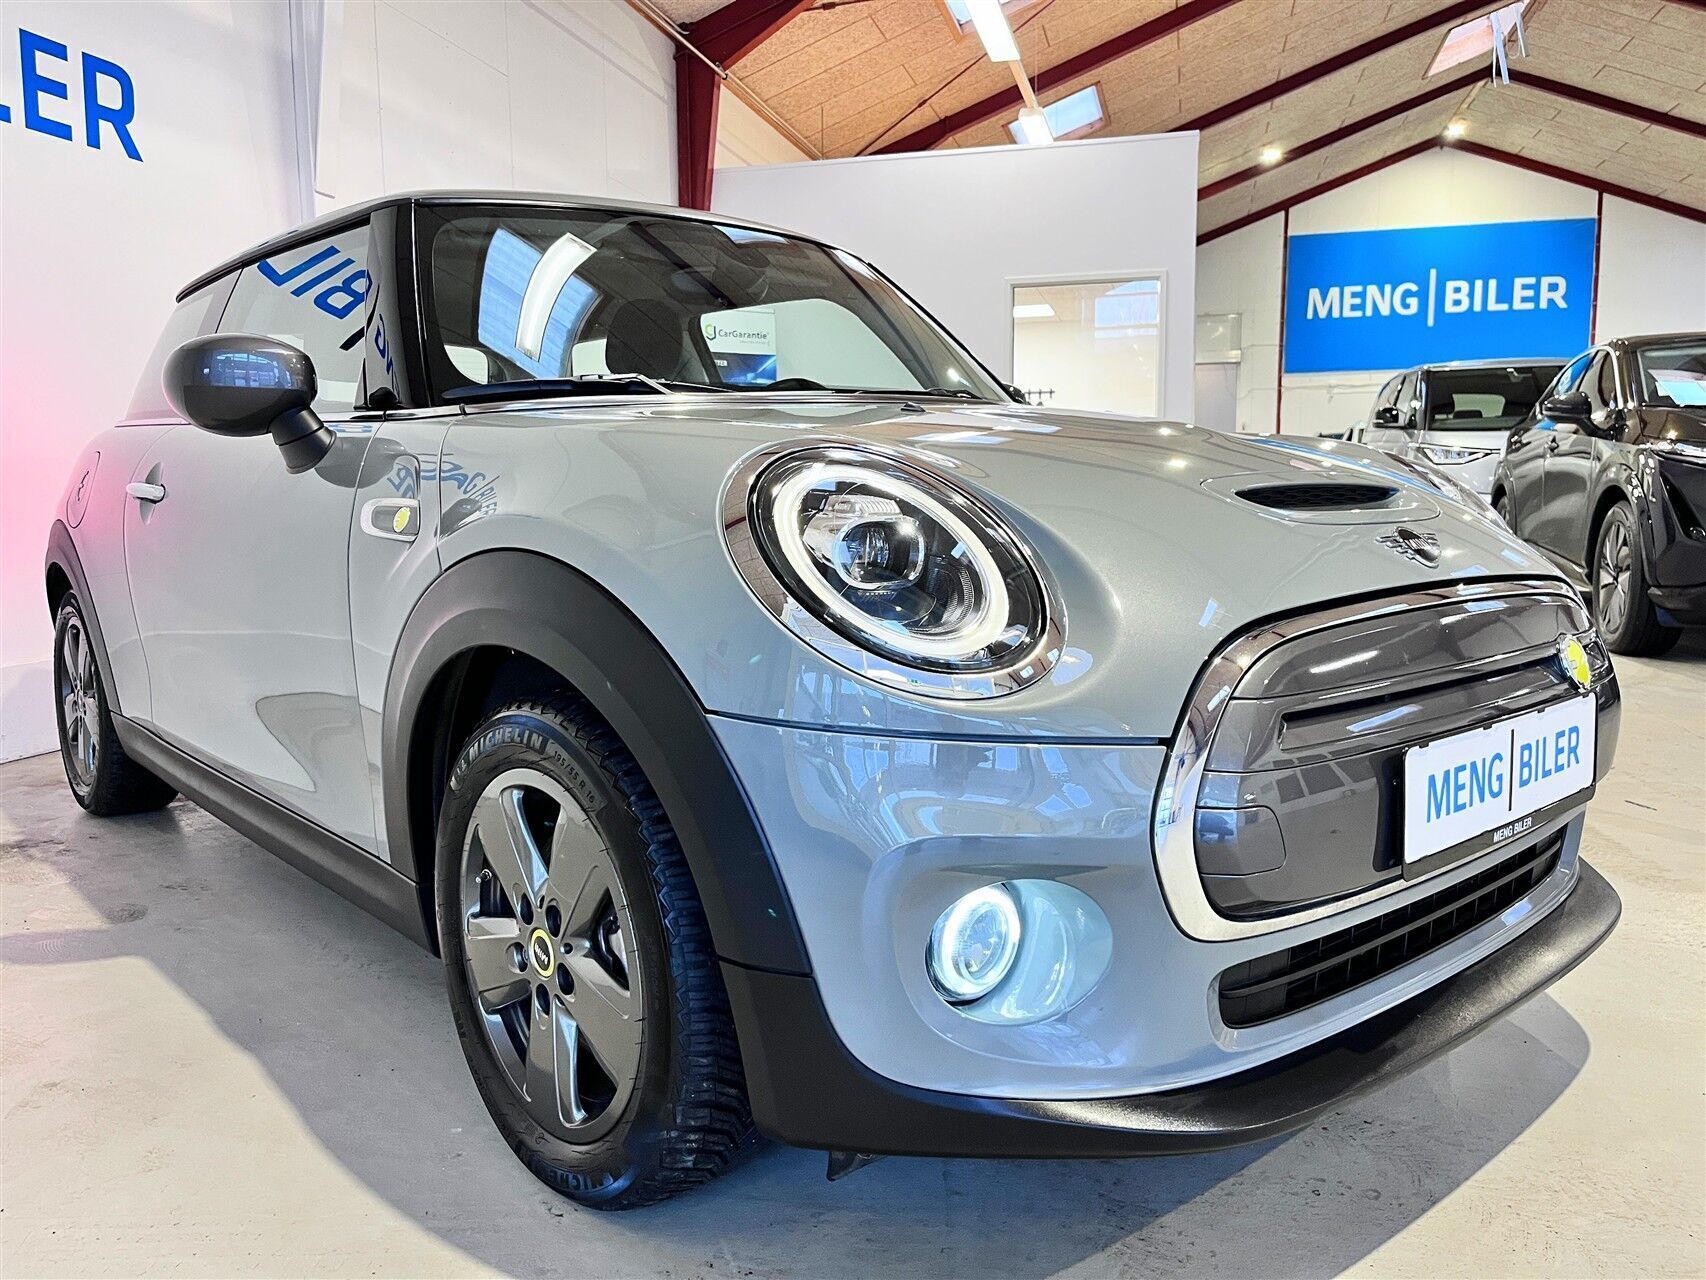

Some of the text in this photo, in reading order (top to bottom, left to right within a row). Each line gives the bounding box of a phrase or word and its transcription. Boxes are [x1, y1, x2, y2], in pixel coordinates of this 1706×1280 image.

[1306, 275, 1569, 320] MENG BILER
[718, 328, 768, 340] CarGarantie
[468, 726, 544, 762] MICHELIN
[553, 750, 580, 781] 195/55
[585, 790, 596, 803] 16
[1426, 725, 1581, 824] MENG BILER
[1493, 816, 1532, 843] MENG BILER
